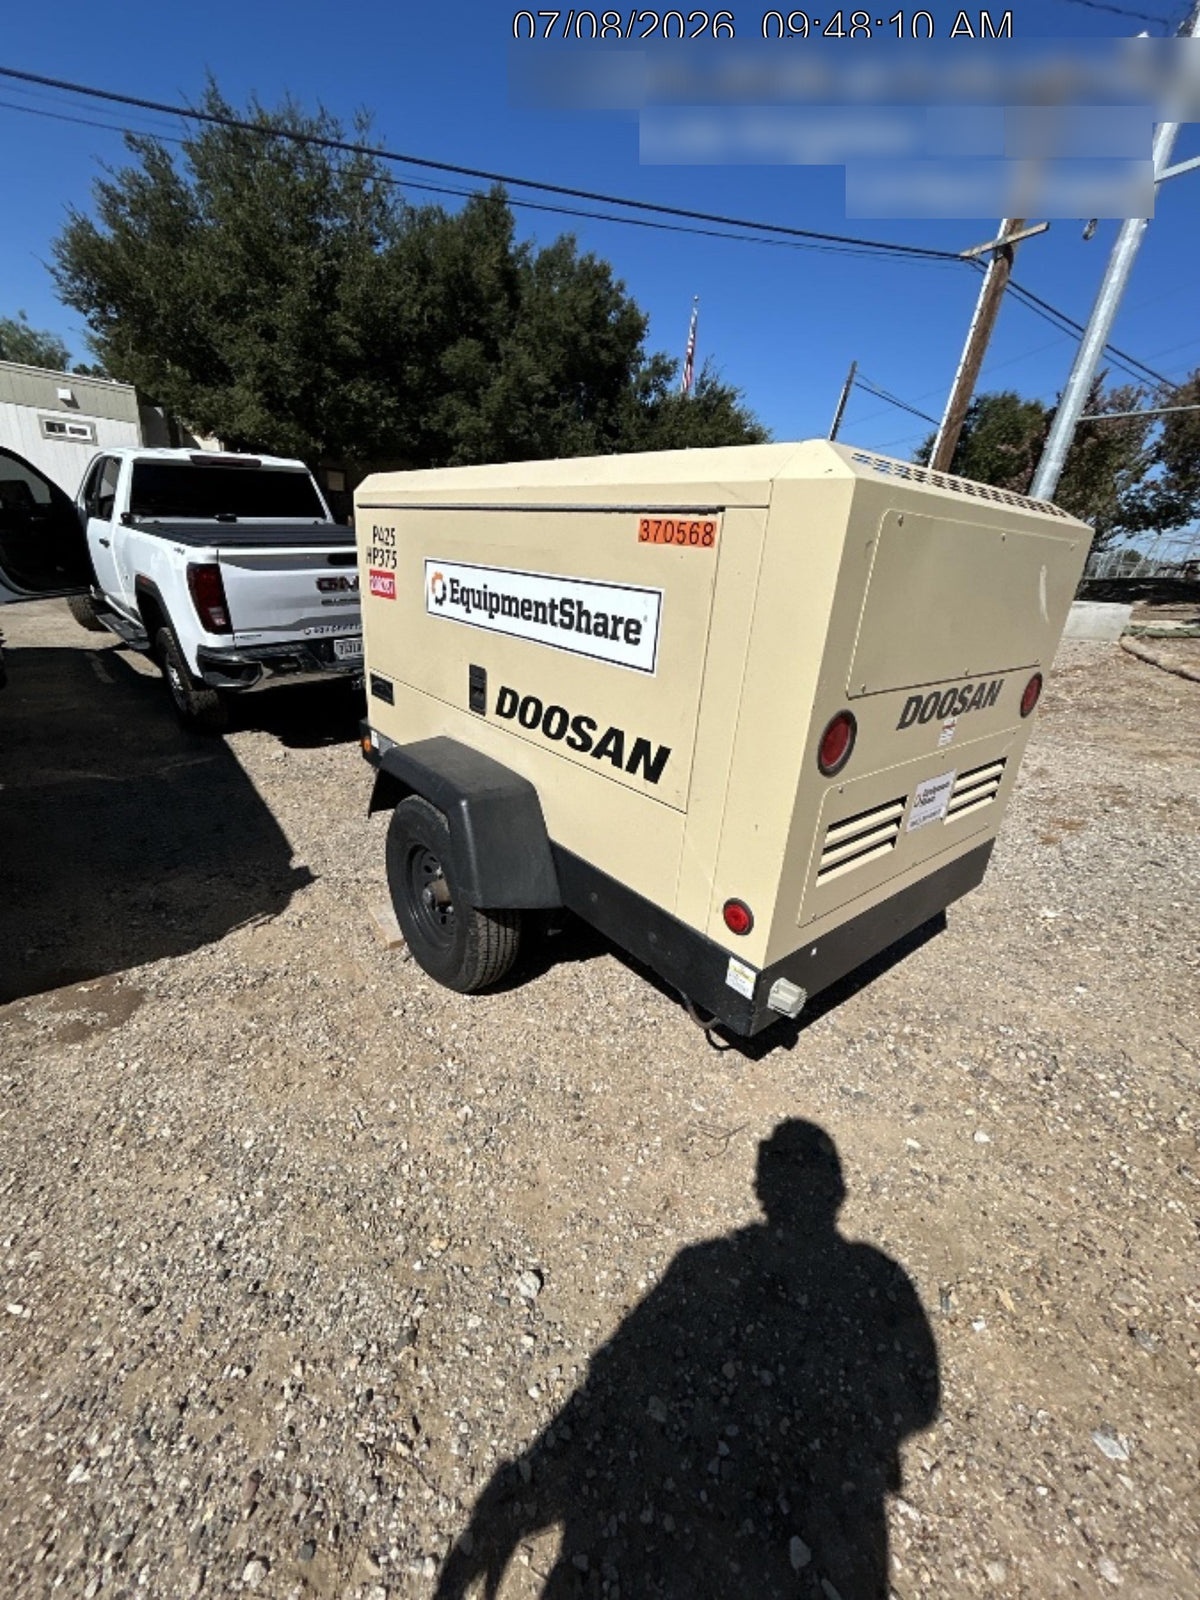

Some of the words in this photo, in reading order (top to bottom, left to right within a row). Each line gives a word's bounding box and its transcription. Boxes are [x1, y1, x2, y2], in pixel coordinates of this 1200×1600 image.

[372, 525, 396, 547] P425
[640, 519, 714, 546] 370568
[366, 546, 398, 570] HP375
[316, 575, 360, 592] GM
[449, 577, 643, 646] EquipmentShare
[895, 679, 1005, 731] DOOSAN
[495, 685, 673, 785] DOOSAN
